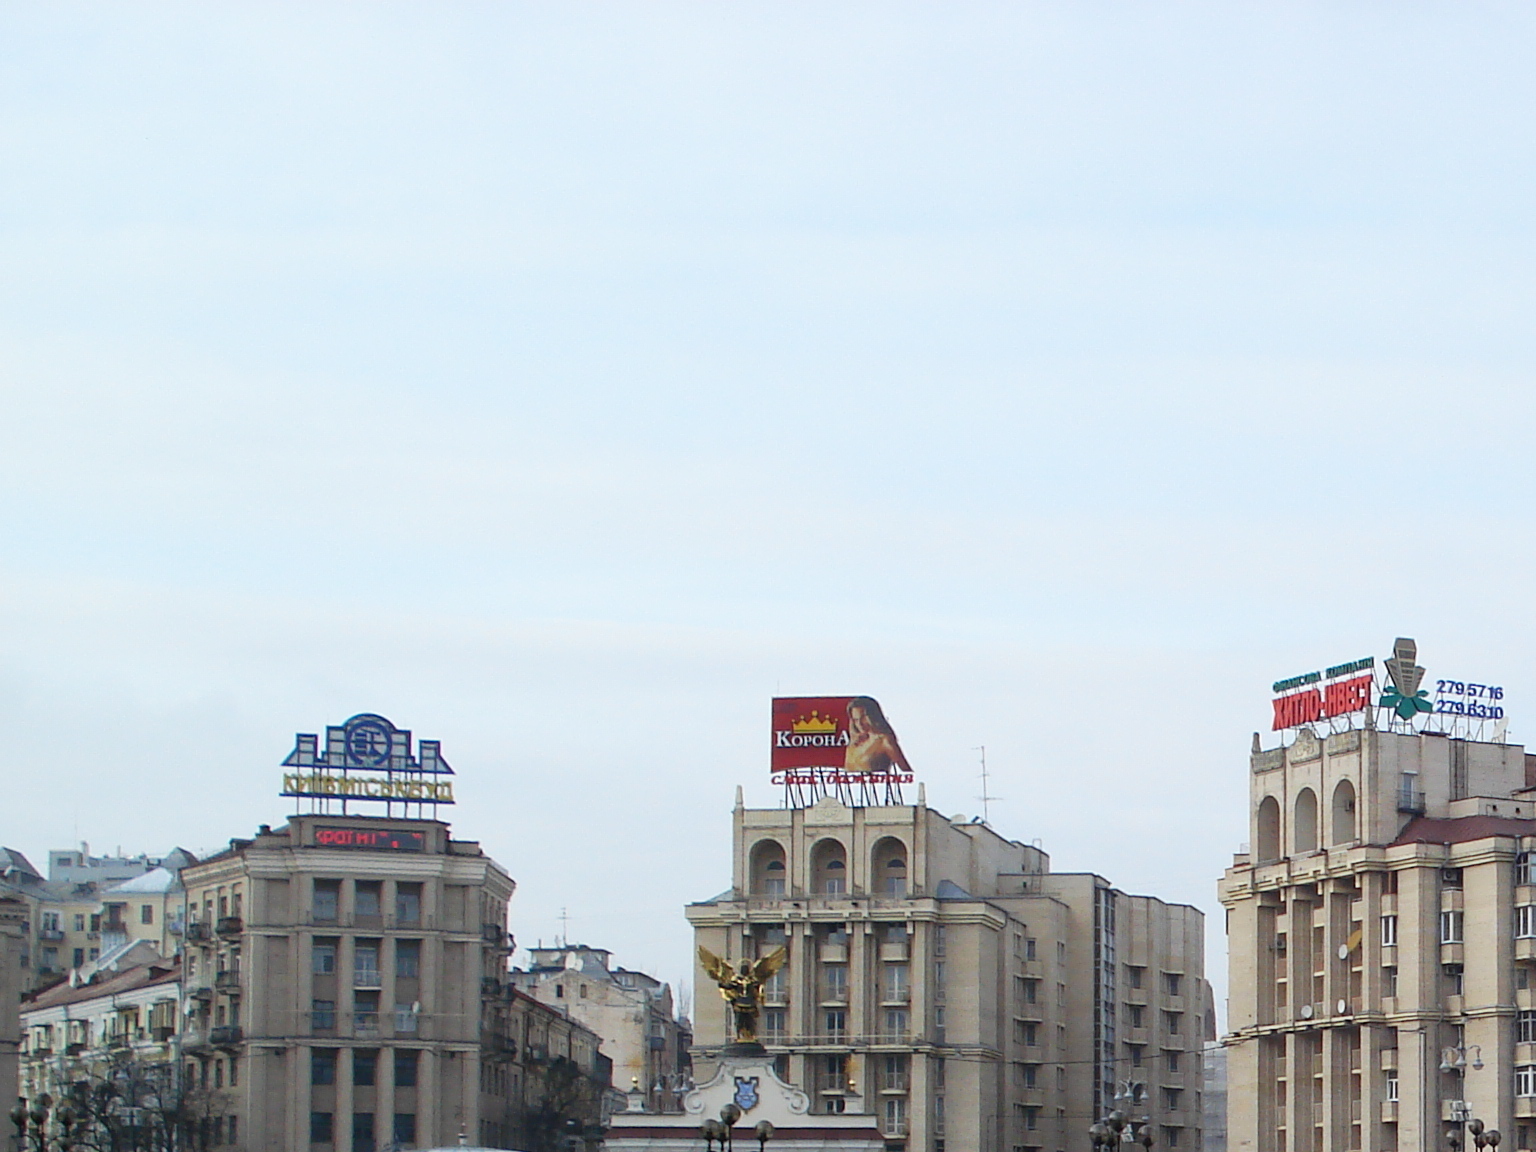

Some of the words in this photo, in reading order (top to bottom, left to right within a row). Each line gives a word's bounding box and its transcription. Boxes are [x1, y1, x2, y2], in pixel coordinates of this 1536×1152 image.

[1436, 679, 1465, 696] 279
[1467, 683, 1504, 700] 5716
[1272, 674, 1374, 731] ЖИТЛО-ІНВЕСТ
[1436, 699, 1465, 716] 279
[283, 772, 454, 802] КИЇВМІСЬКБУД
